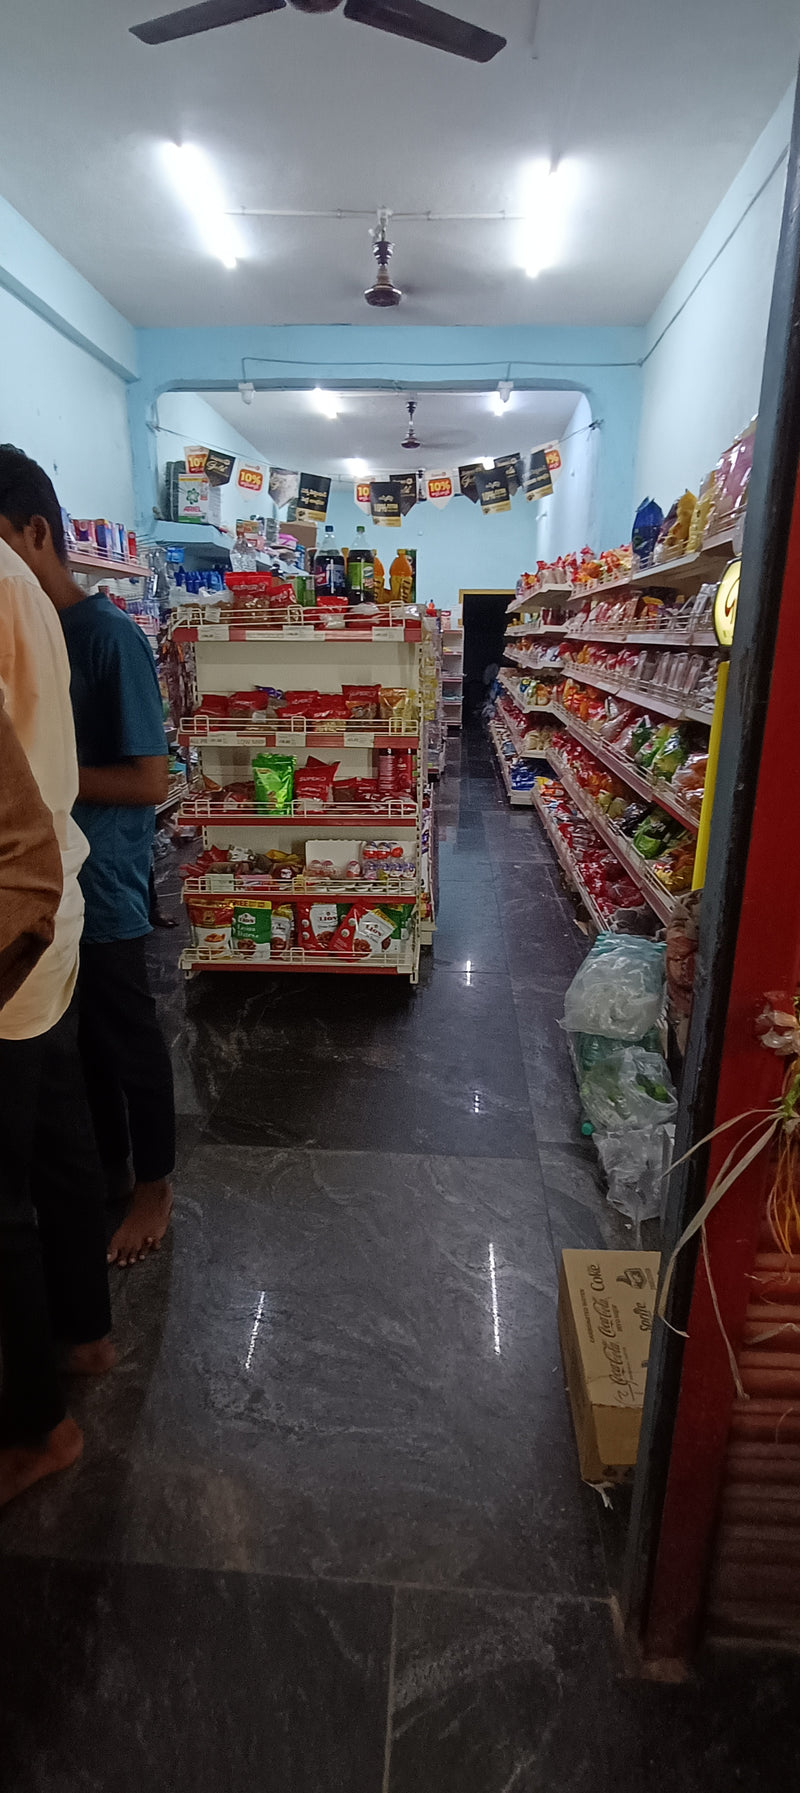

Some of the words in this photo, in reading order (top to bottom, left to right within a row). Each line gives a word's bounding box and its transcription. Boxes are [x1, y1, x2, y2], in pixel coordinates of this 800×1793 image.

[241, 471, 262, 486] 10%
[429, 482, 450, 492] 10%
[590, 1264, 605, 1292] Coke
